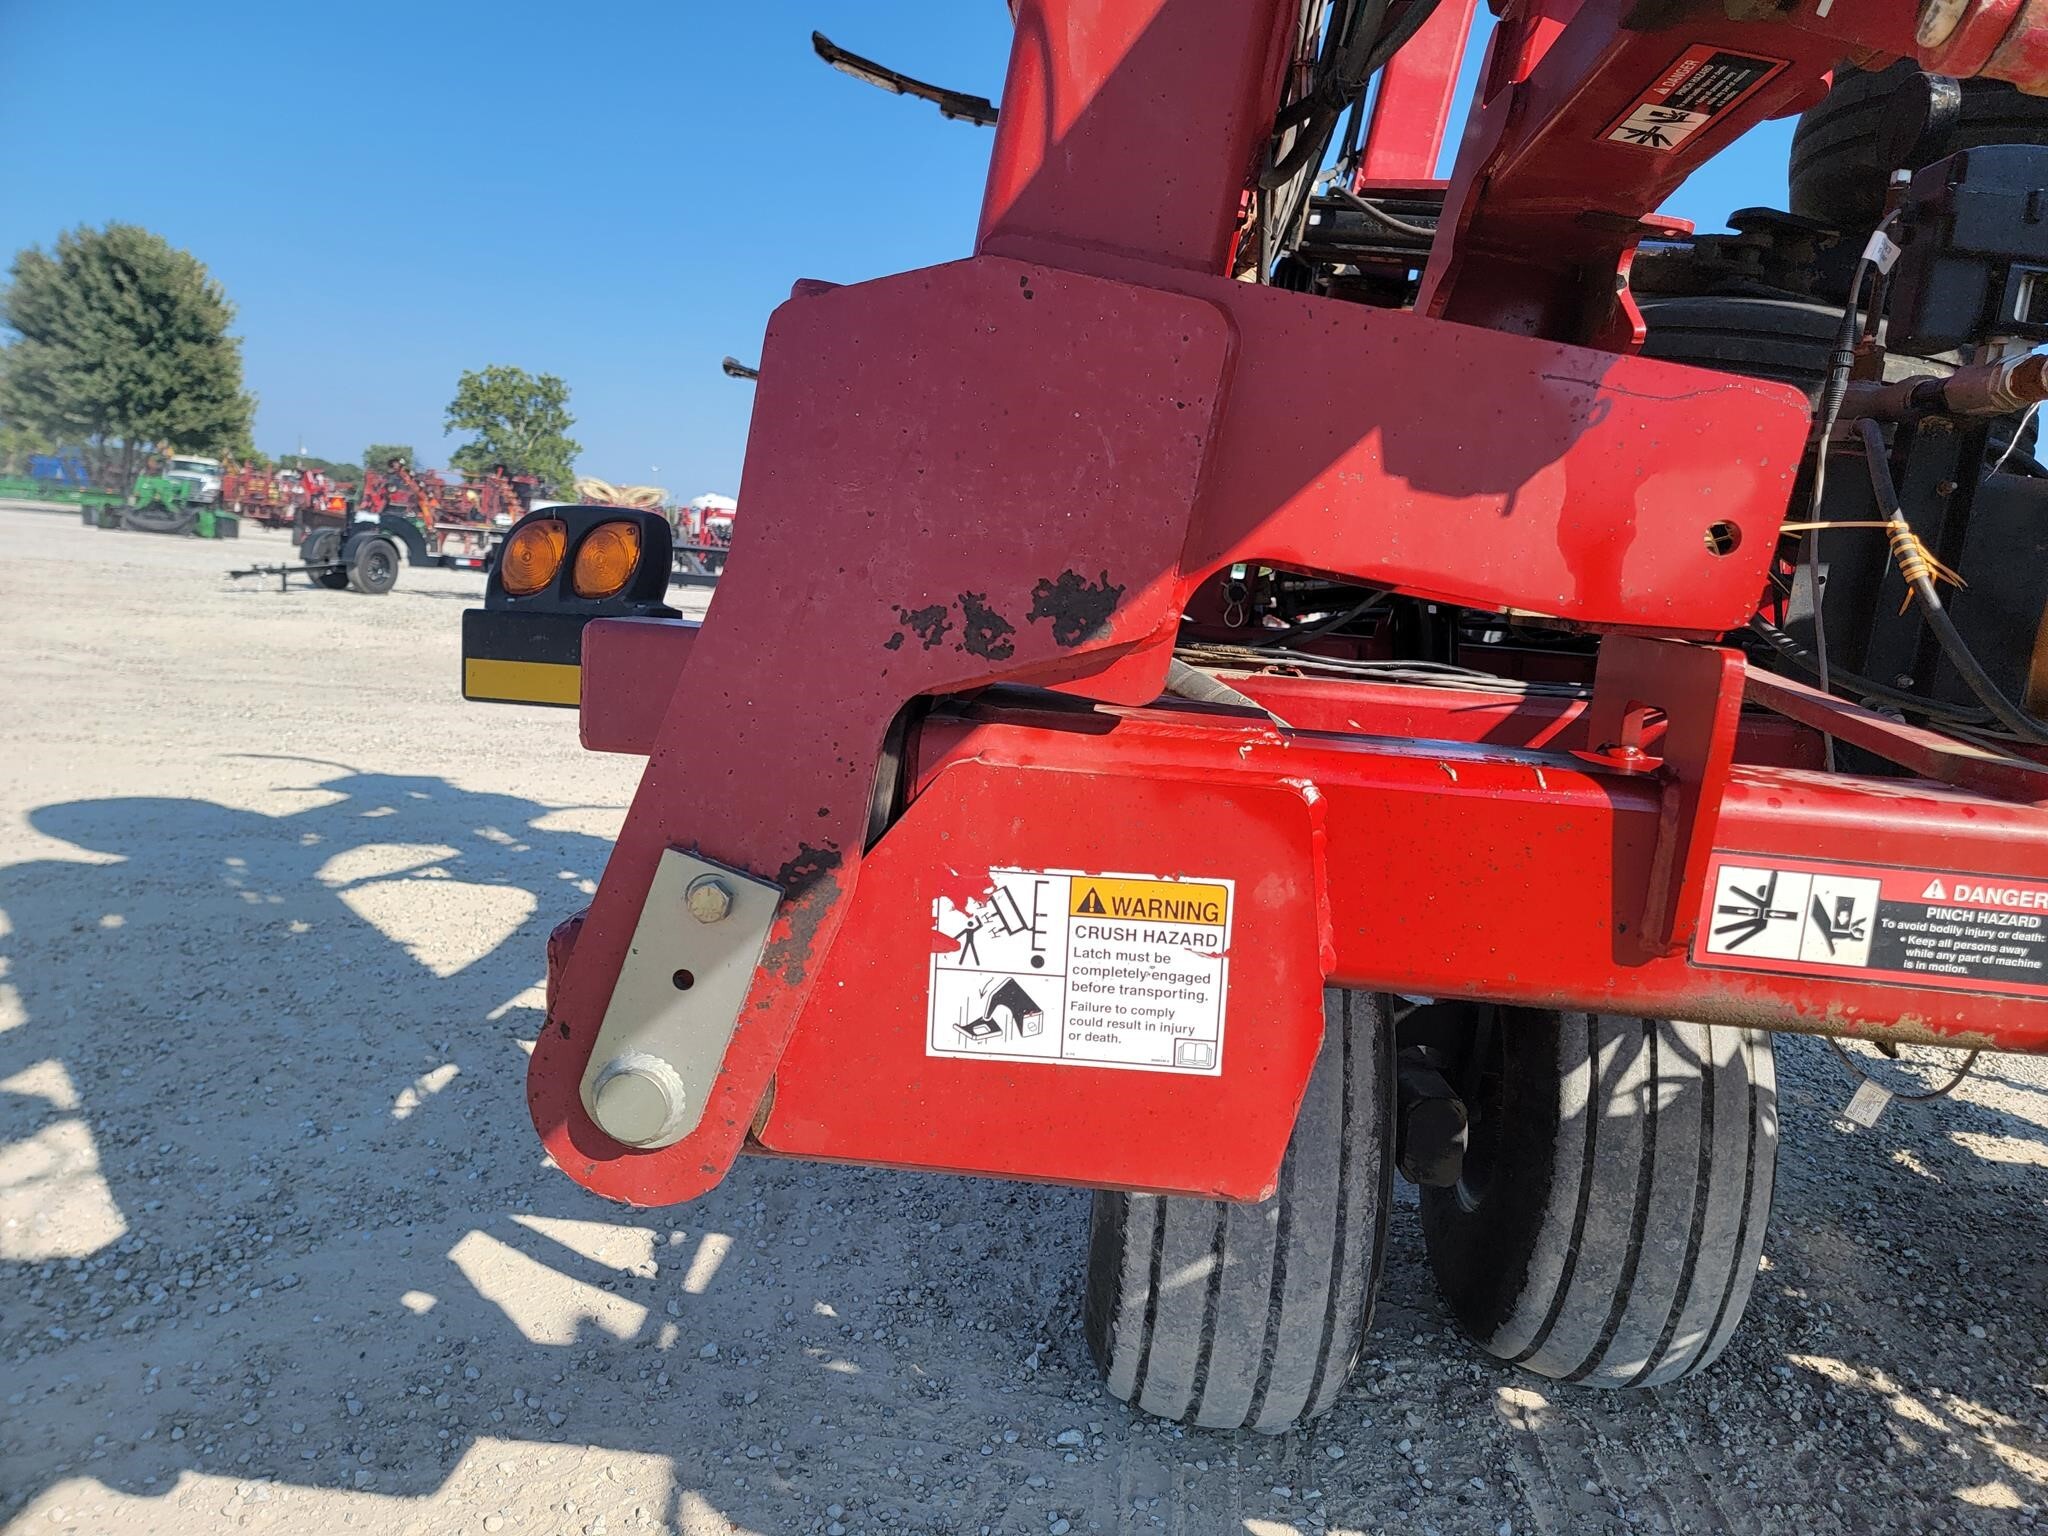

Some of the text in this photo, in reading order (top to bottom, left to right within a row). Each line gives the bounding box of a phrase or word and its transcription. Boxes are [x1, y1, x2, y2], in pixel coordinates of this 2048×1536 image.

[1661, 59, 1700, 87] DANGER
[1953, 884, 2048, 910] DANGER
[1112, 896, 1219, 922] WARNING
[1926, 906, 2041, 928] PINCH HAZARD
[1075, 925, 1218, 947] CRUSH HAZARD
[1881, 918, 2046, 942] To avoid bodily injury or death:
[1074, 946, 1171, 964] Latch must be
[1908, 936, 2029, 957] Keep all persons away
[1903, 960, 1968, 974] is in motion.
[1906, 948, 2042, 969] while any part of machine
[1072, 966, 1211, 986] completely engaged
[1072, 981, 1208, 1003] before transporting.
[1070, 1000, 1176, 1020] Failure to comply
[1069, 1017, 1196, 1036] could result in injury
[1068, 1032, 1122, 1044] or death.
